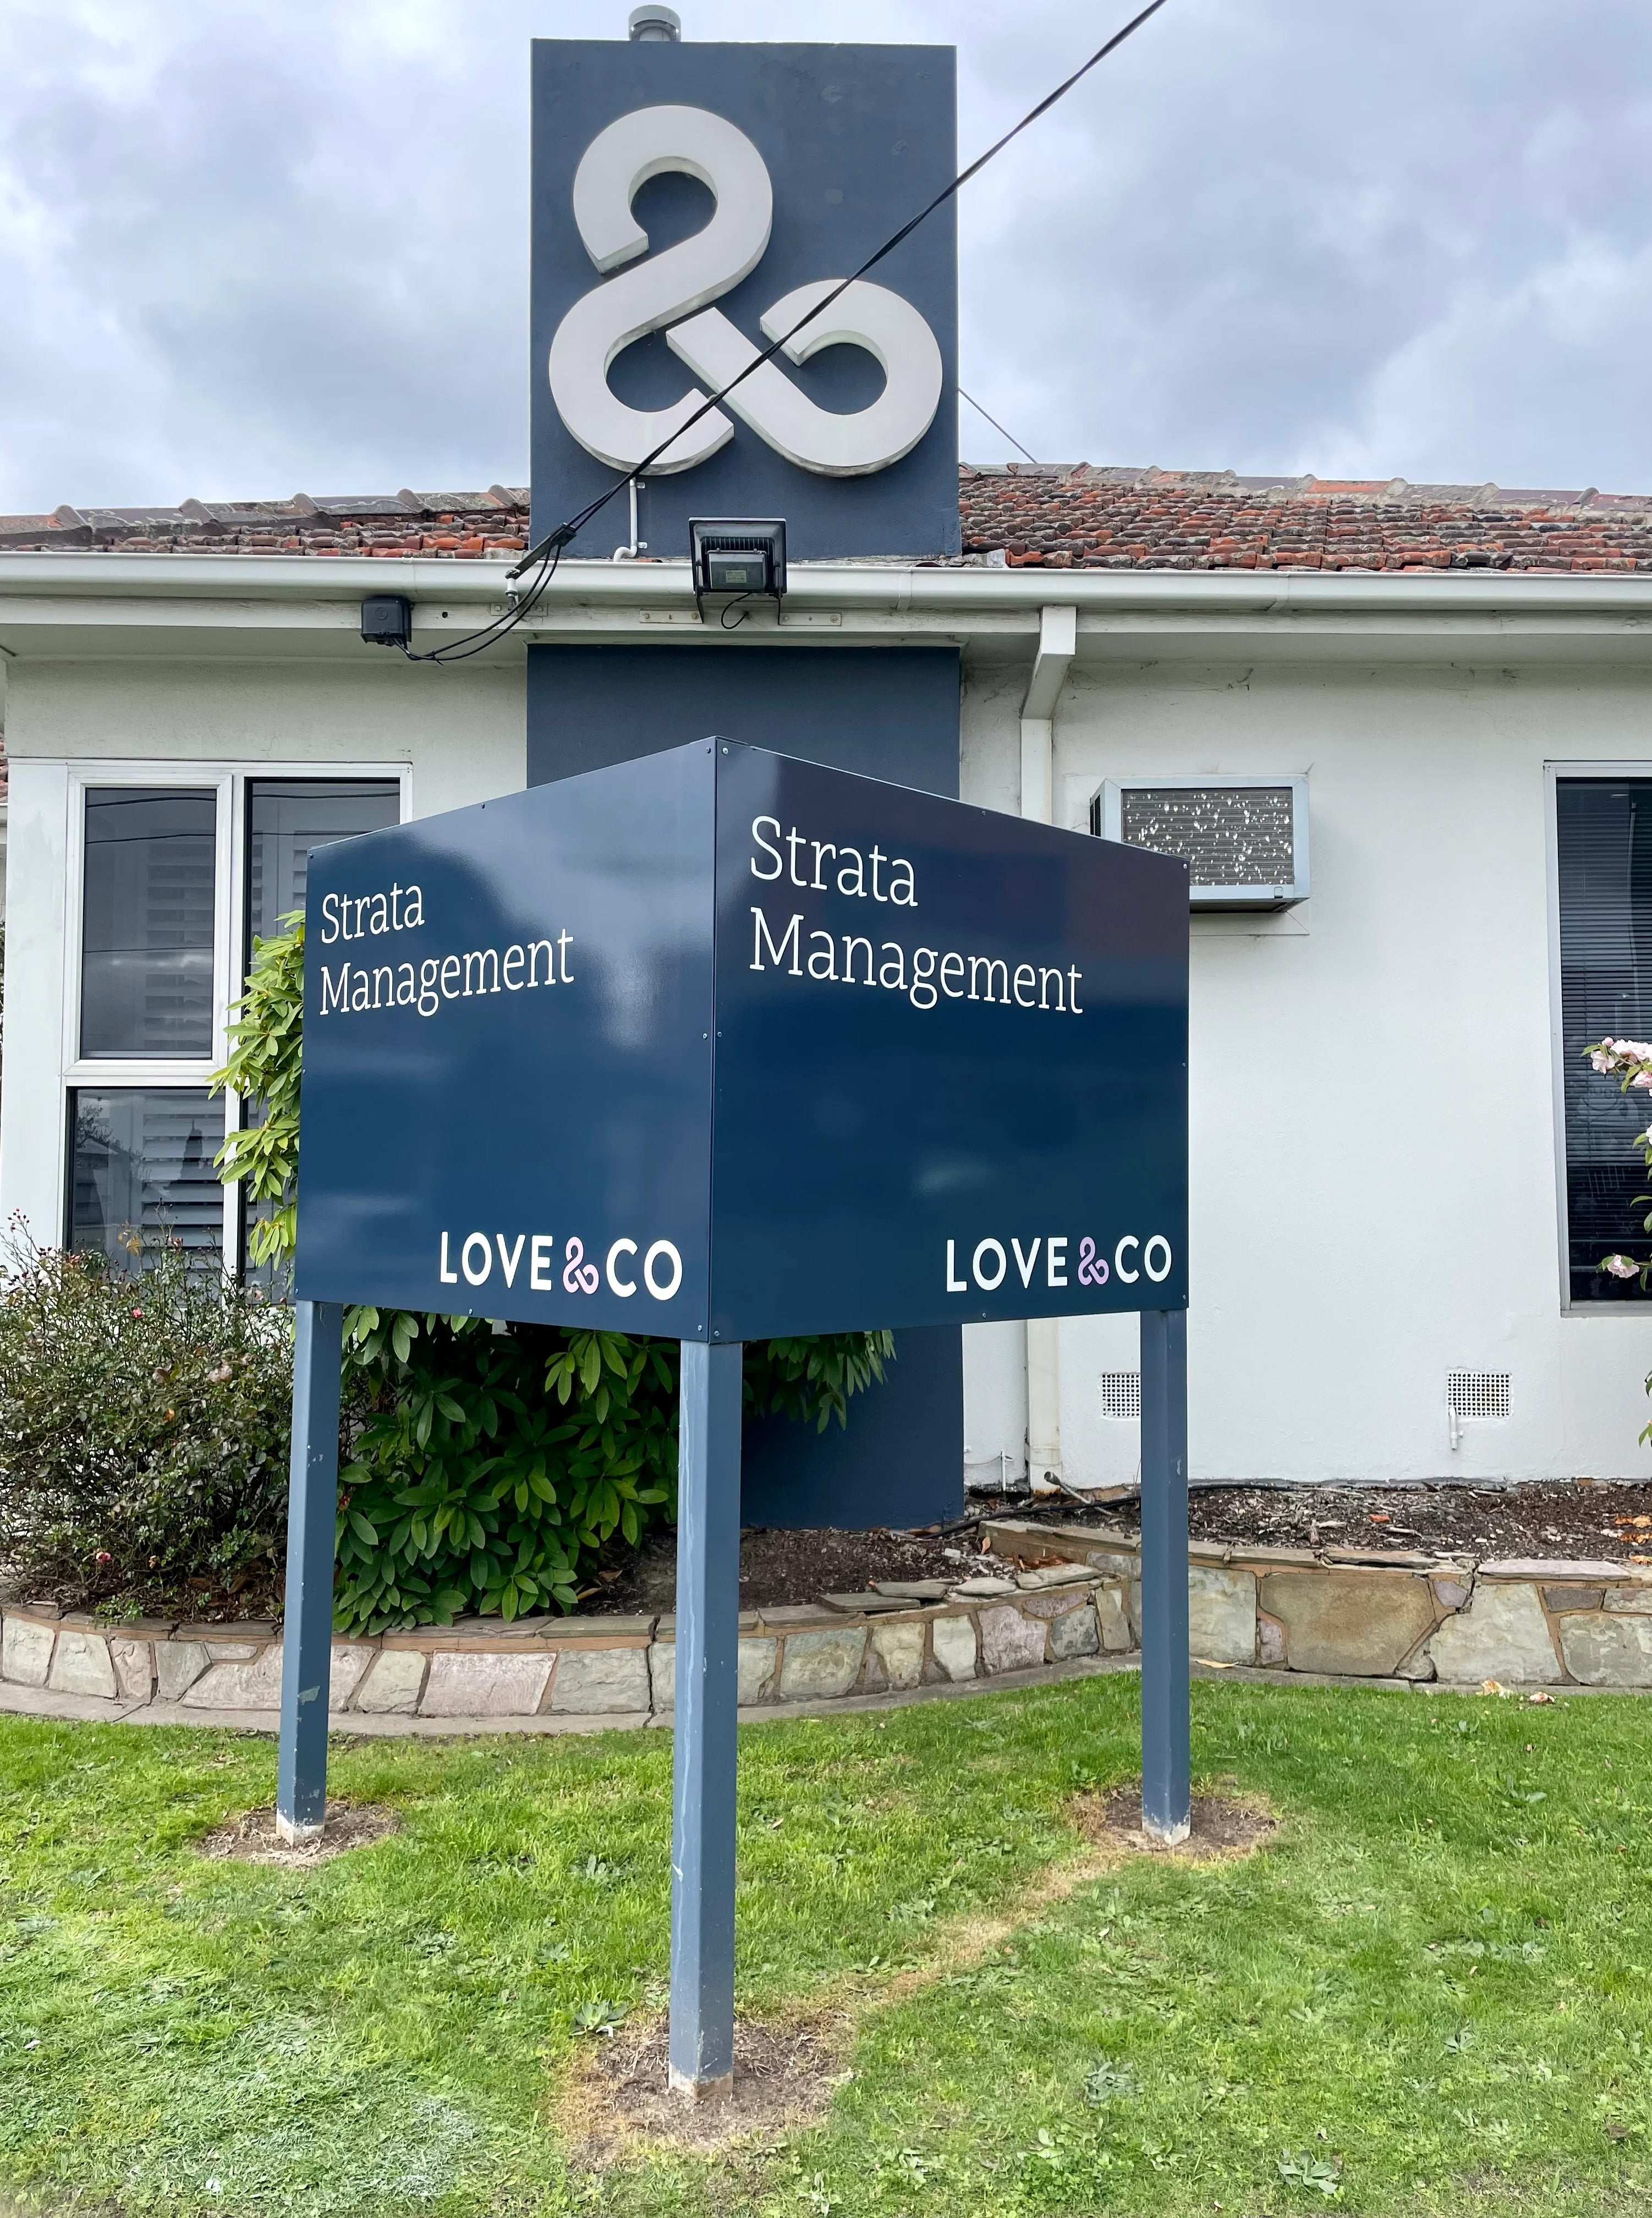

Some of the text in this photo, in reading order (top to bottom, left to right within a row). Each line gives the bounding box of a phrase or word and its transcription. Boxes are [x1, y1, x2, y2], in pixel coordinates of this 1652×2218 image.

[751, 816, 918, 907] Strata
[321, 882, 425, 943] Strata
[320, 928, 574, 1017] Management
[749, 907, 1083, 1014] Management
